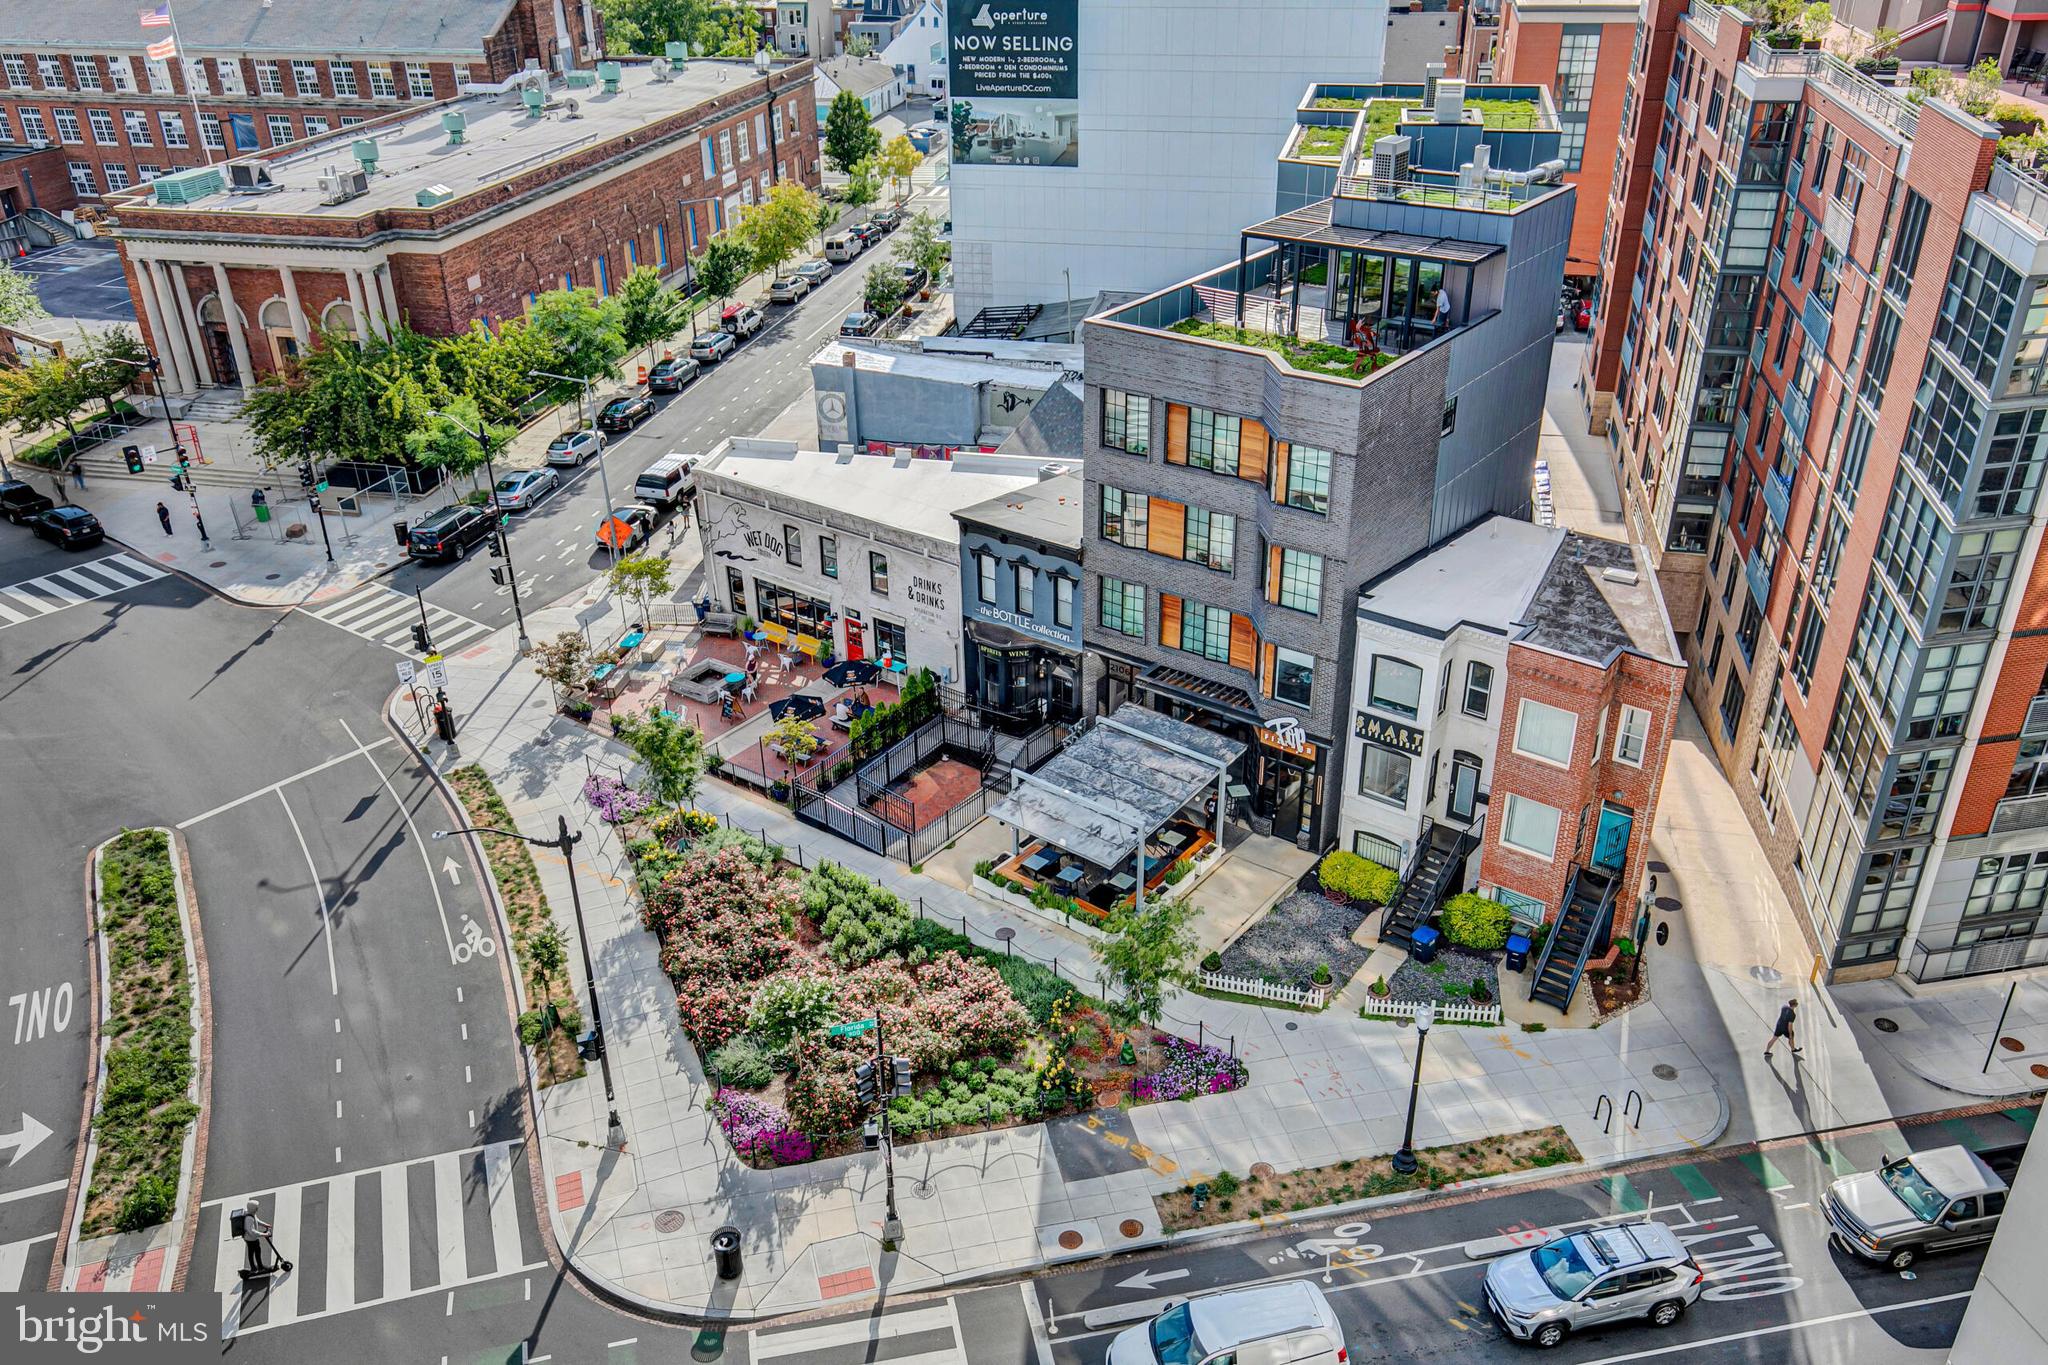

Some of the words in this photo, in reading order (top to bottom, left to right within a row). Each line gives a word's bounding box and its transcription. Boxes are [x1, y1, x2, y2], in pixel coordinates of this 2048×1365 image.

[993, 8, 1048, 24] aperture
[954, 35, 997, 50] NOW
[1002, 36, 1073, 51] SELLING
[975, 84, 1052, 93] LiveApertureDC.com
[743, 530, 762, 548] WET
[764, 532, 784, 557] DOG
[913, 575, 942, 595] DRINKS
[907, 585, 914, 600] &
[916, 591, 945, 610] DRINKS
[980, 605, 992, 616] the
[992, 607, 1031, 629] BOTTLE
[1031, 624, 1070, 643] collection
[432, 670, 443, 679] 15
[1356, 715, 1423, 746] SMART
[840, 1023, 865, 1032] Florida
